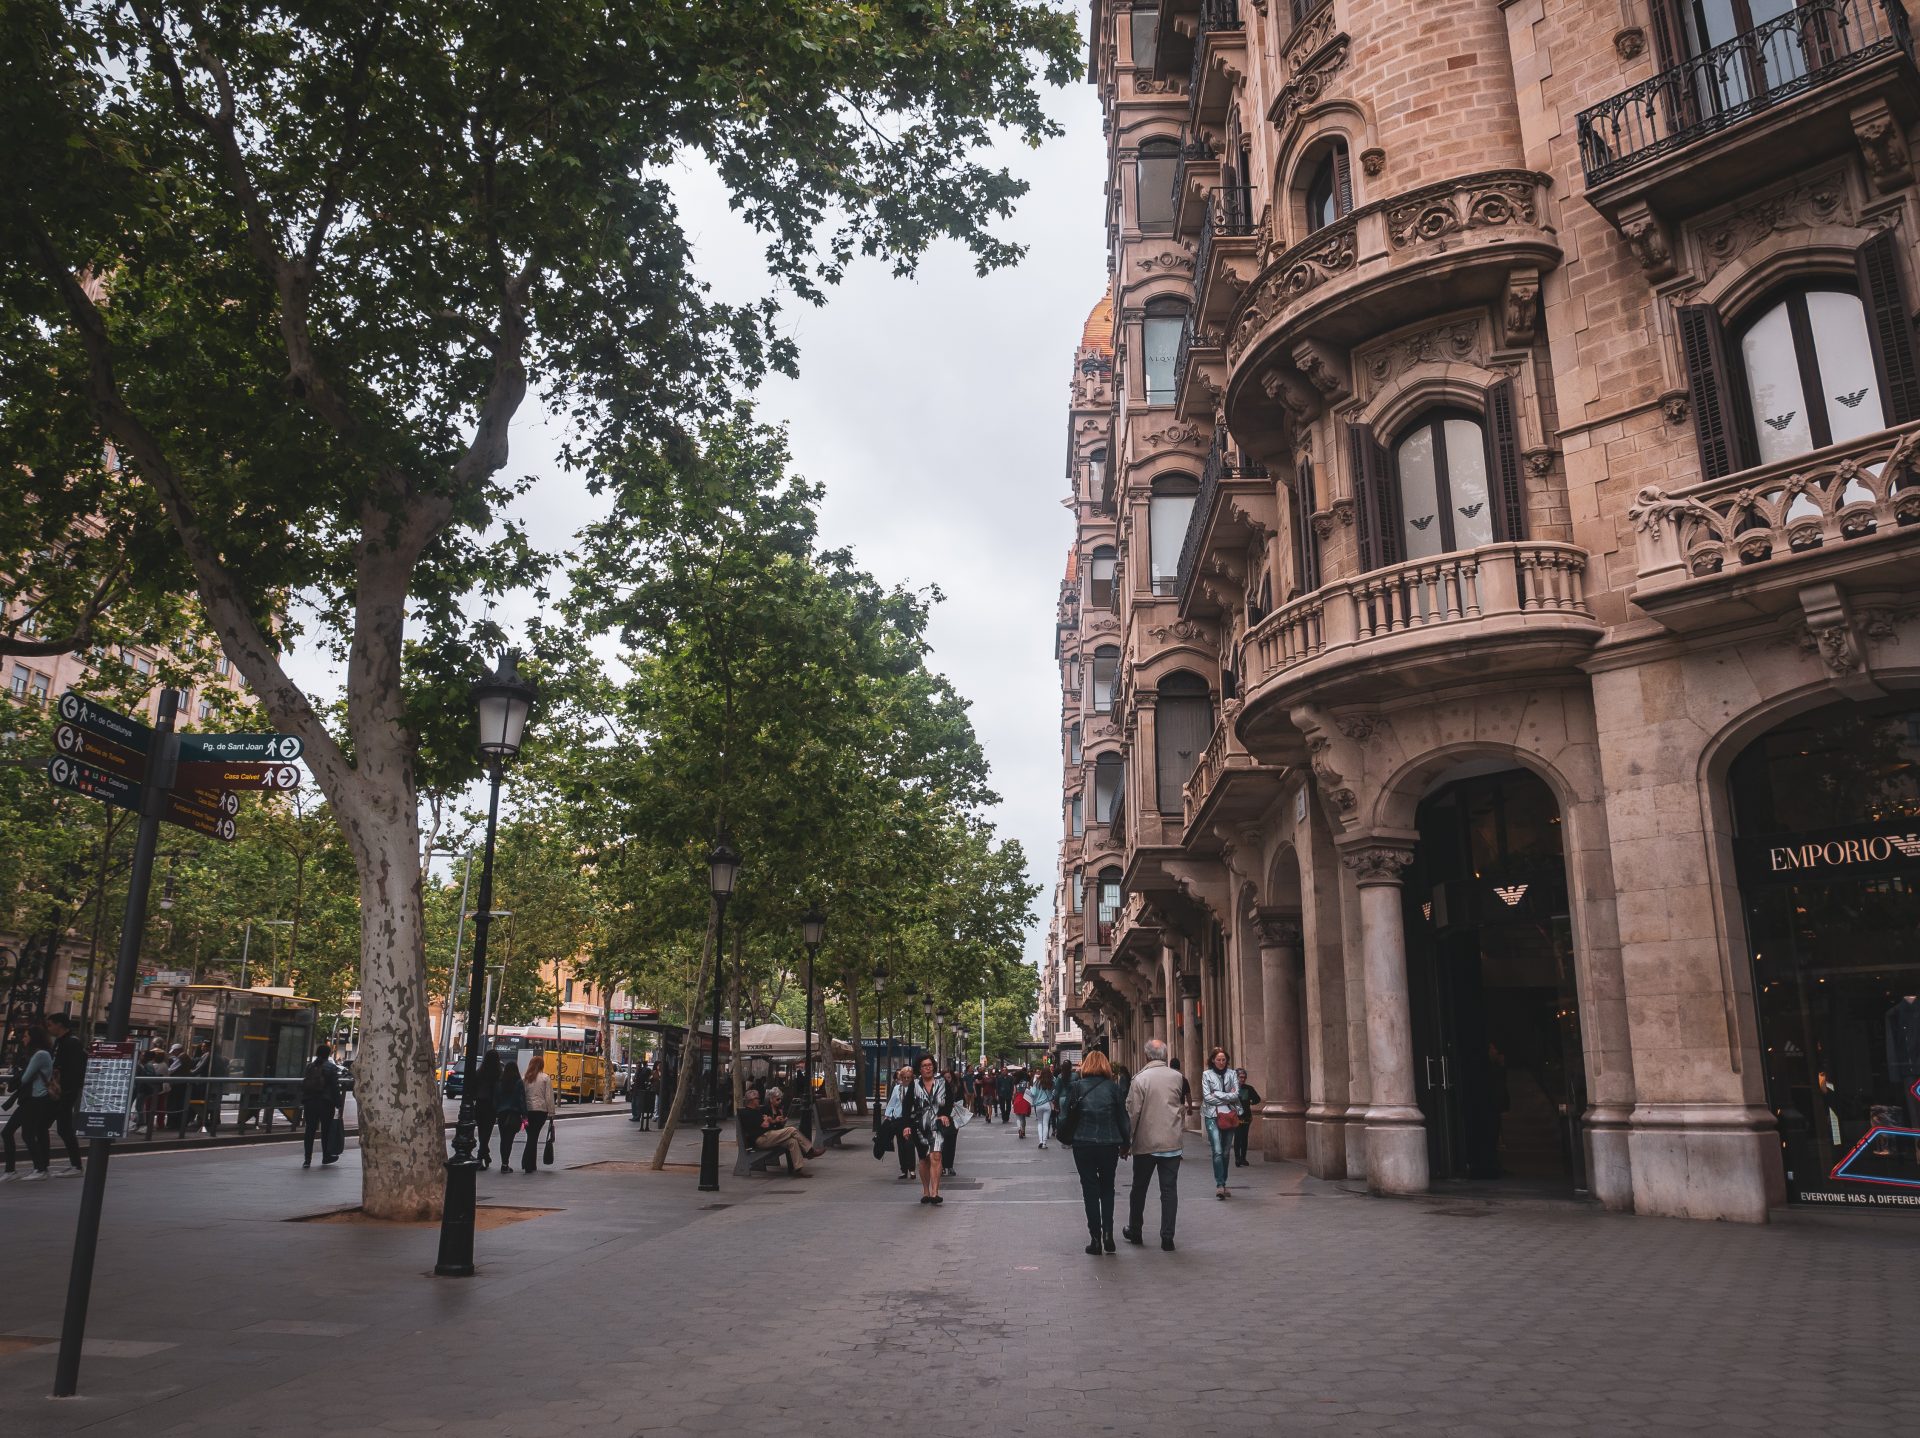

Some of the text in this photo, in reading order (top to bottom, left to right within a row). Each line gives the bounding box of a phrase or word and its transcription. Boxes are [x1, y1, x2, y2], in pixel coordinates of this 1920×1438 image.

[98, 717, 106, 726] de
[106, 719, 133, 737] Catalunya
[203, 743, 215, 752] Pg.
[245, 743, 264, 751] Joan
[224, 772, 261, 781] Casa Calvet
[1769, 836, 1892, 871] EMPORIO
[1800, 1192, 1920, 1206] EVERYONE HAS A DIFFEREN
